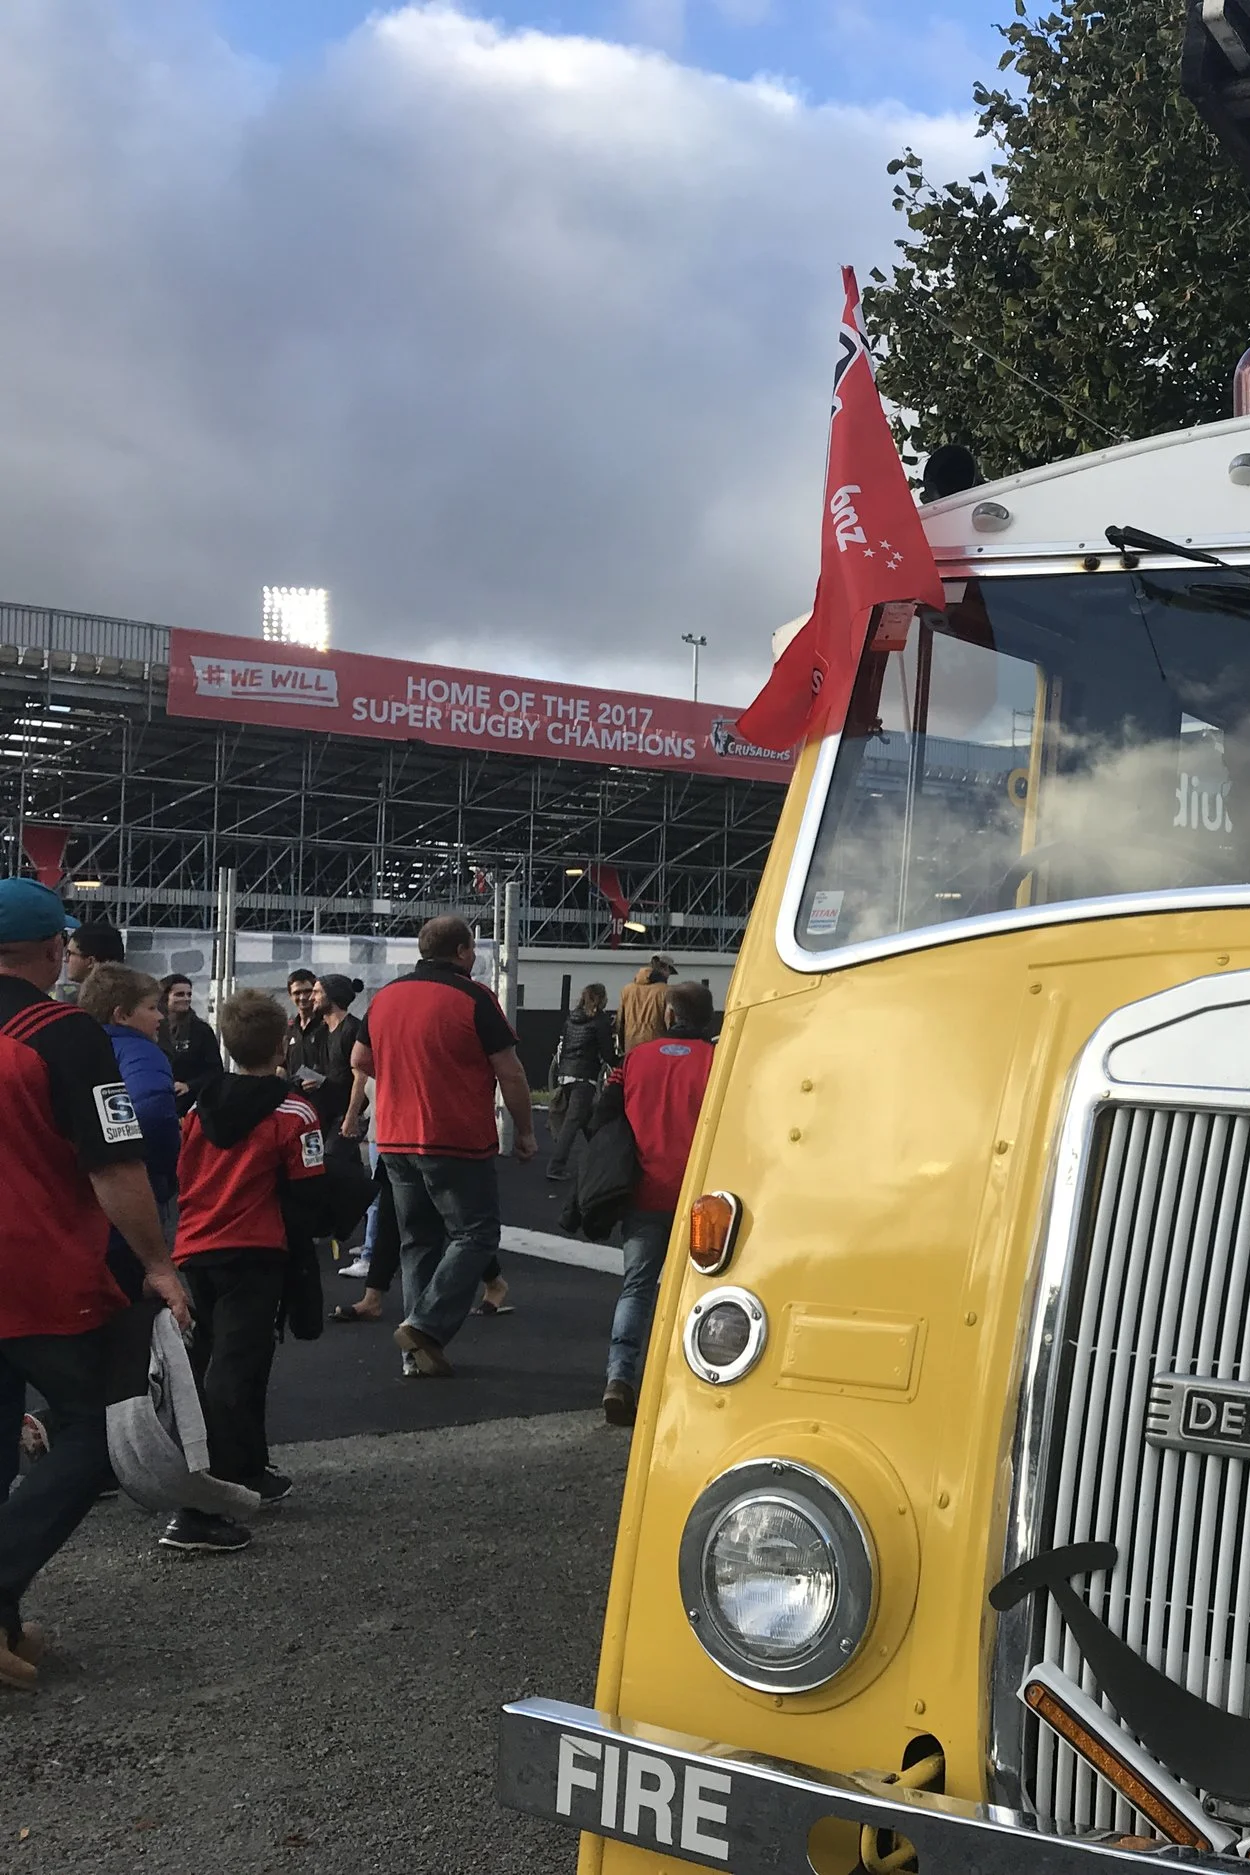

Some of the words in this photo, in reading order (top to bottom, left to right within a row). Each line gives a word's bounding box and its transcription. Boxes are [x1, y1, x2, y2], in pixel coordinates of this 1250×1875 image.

[830, 484, 868, 553] bnz
[271, 669, 328, 691] WILL
[406, 676, 491, 709] HOME
[499, 689, 536, 713] OF
[542, 694, 590, 721] THE
[597, 703, 653, 728] 2017
[352, 697, 442, 730] SUPER
[450, 709, 541, 741] RUGBY
[547, 721, 696, 760] CHAMPIONS
[727, 742, 791, 761] CRUSADERS
[555, 1733, 732, 1861] FIRE
